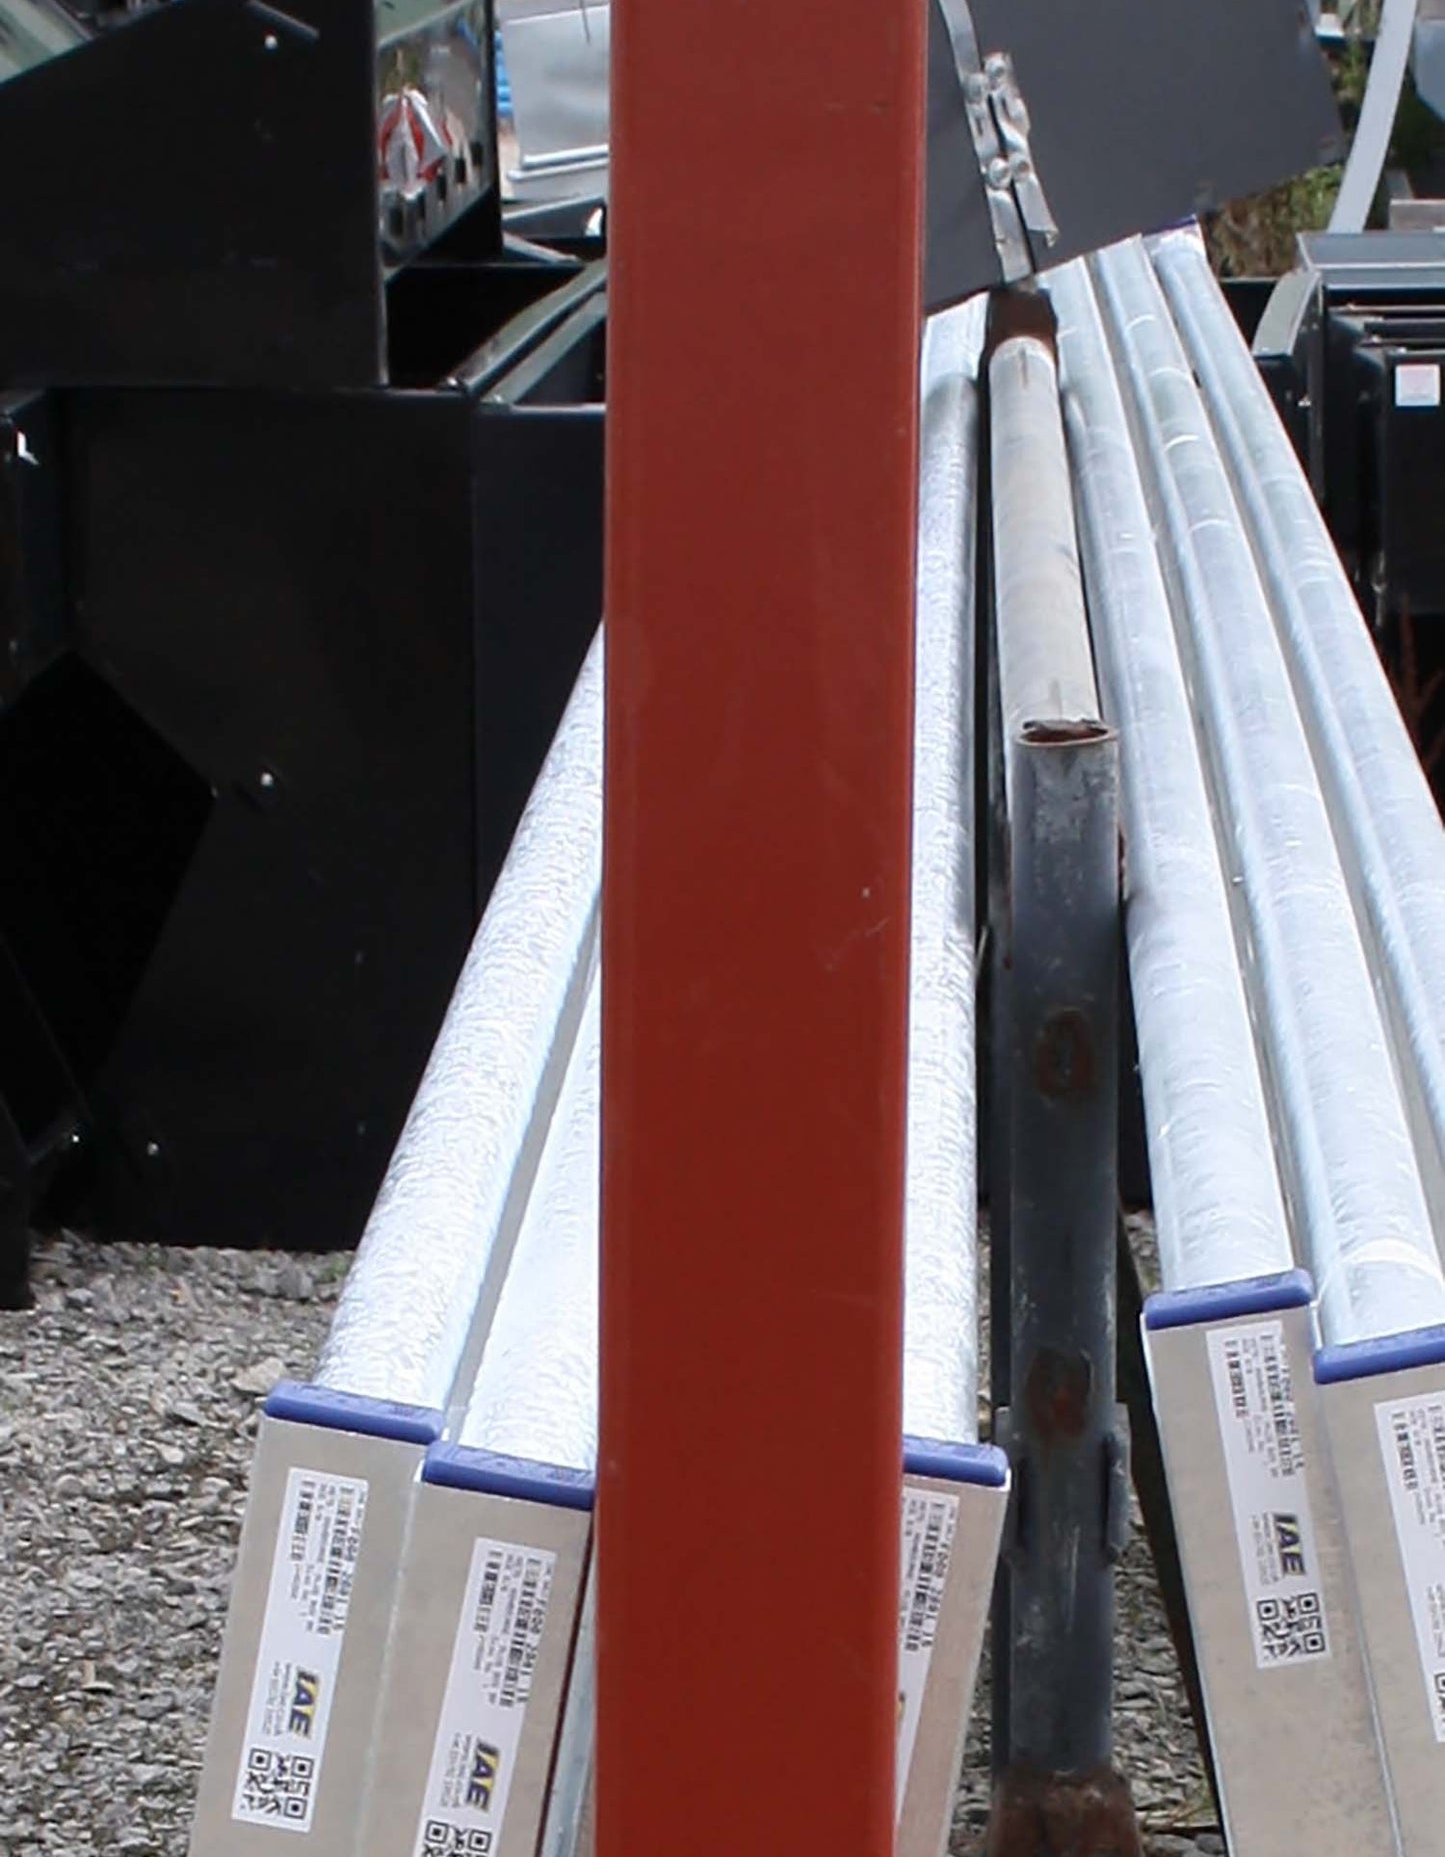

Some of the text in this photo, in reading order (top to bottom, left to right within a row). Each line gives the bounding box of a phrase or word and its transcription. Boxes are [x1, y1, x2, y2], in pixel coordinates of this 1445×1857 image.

[1274, 1514, 1306, 1576] IAE
[288, 1667, 318, 1738] IAE
[466, 1739, 500, 1812] IAE
